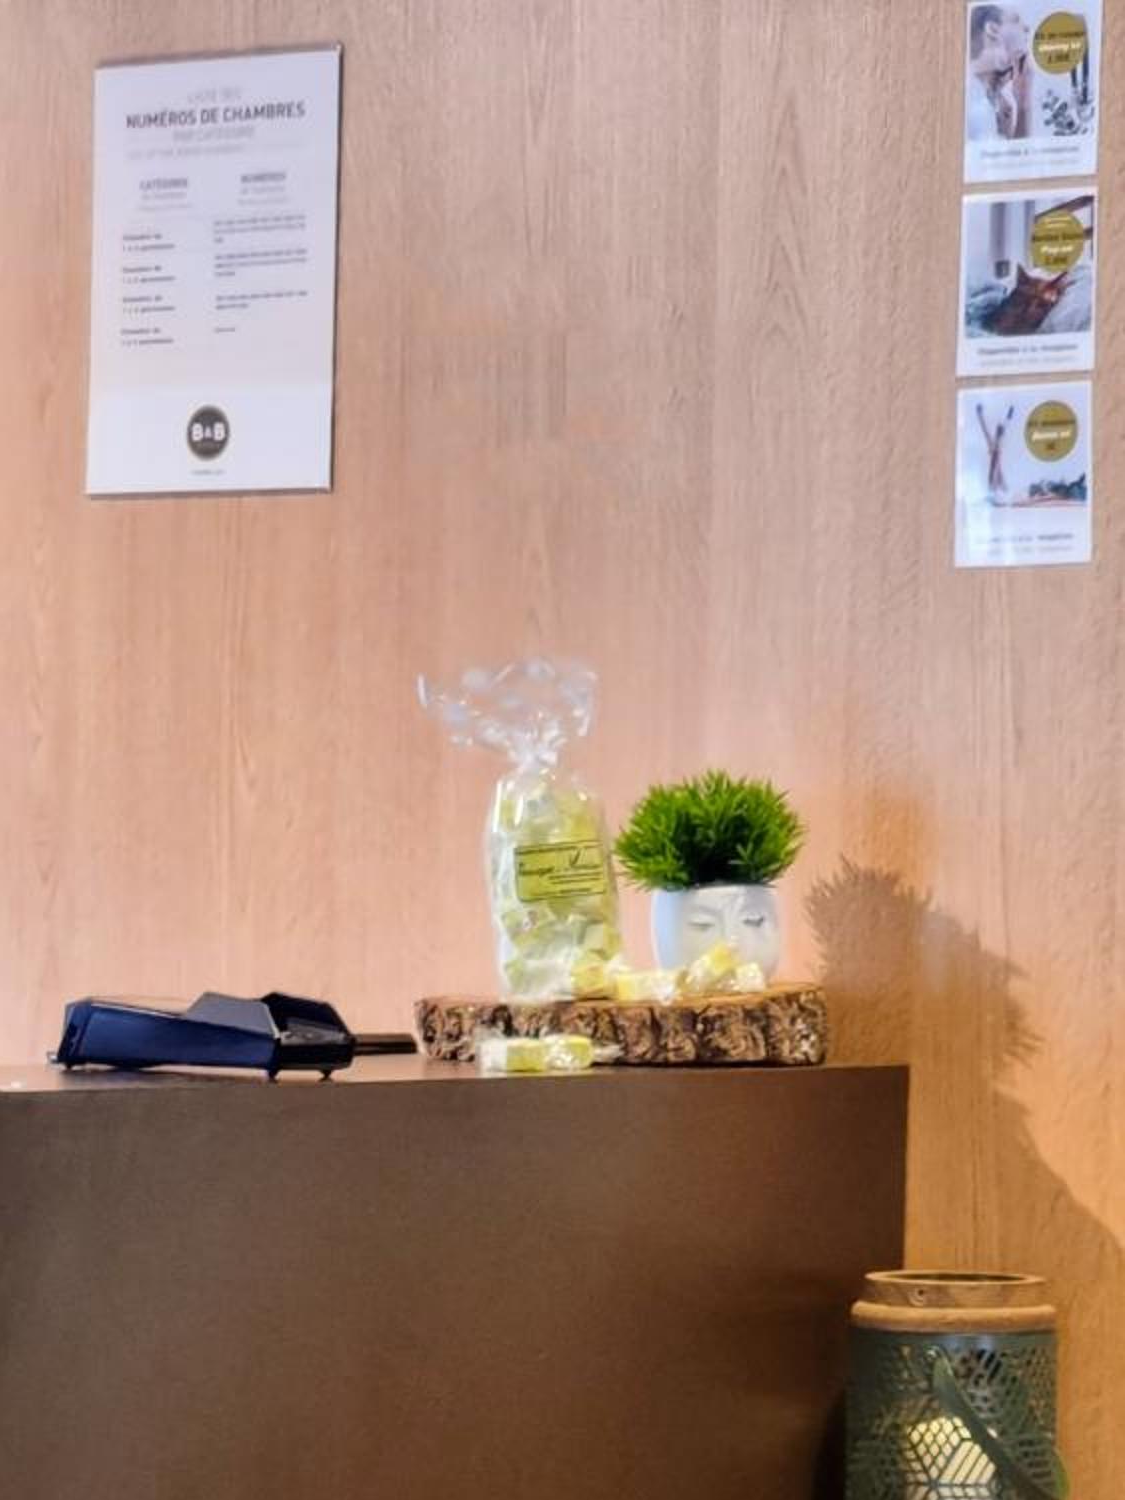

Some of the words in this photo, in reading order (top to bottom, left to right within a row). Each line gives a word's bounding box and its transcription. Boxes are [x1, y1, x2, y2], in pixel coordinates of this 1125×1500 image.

[125, 107, 197, 129] NUMÉROS
[200, 107, 219, 125] DE
[222, 100, 307, 123] CHAMBRES
